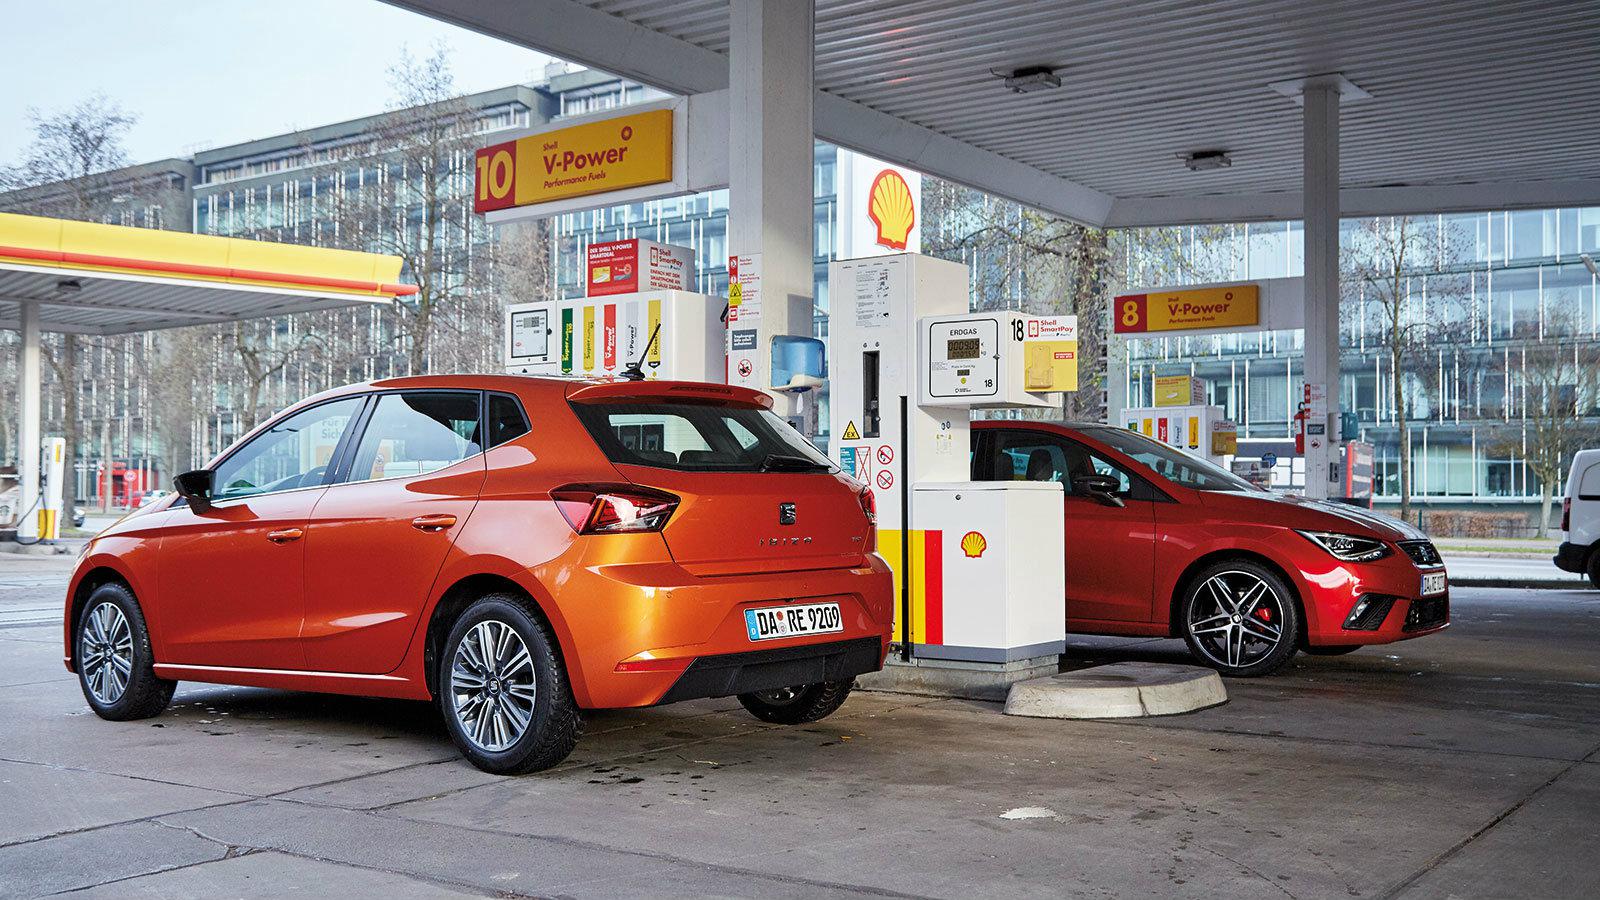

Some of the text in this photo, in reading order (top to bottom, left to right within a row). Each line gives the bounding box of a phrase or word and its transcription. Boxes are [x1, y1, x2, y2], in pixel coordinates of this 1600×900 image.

[543, 141, 558, 152] Shell
[543, 146, 628, 175] V-Power
[477, 150, 514, 201] 10
[543, 169, 606, 189] Performance Fuels
[612, 243, 632, 251] V-POWER
[659, 256, 683, 267] SmartPay
[1122, 301, 1139, 327] 8
[1168, 302, 1230, 317] V-Power
[950, 328, 978, 336] ERDGAS
[1011, 318, 1024, 342] 18
[984, 379, 993, 388] 18
[759, 537, 812, 546] IBIZA
[757, 612, 779, 636] DA
[787, 608, 808, 632] RE
[808, 606, 840, 630] 9209
